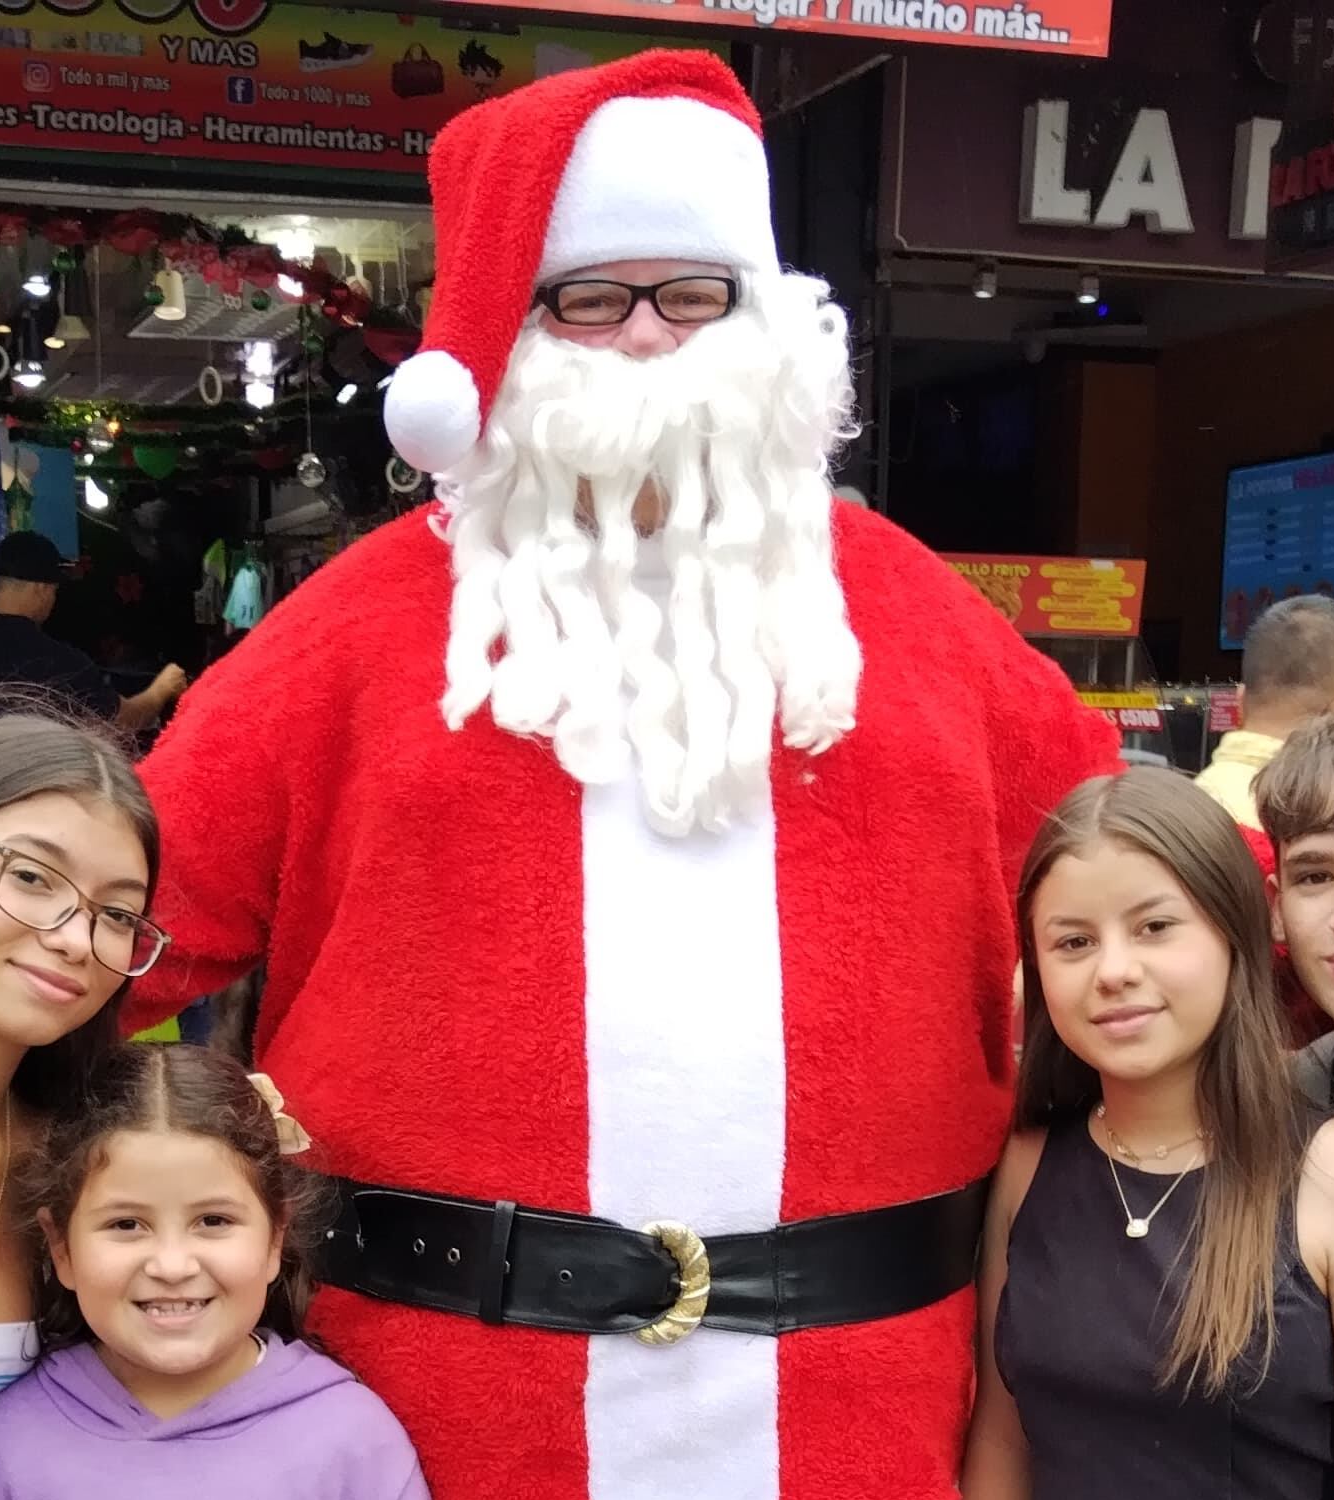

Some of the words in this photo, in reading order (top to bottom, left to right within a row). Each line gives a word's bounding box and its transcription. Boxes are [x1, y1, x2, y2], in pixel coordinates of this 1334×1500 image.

[850, 0, 967, 33] mucho
[974, 4, 1070, 44] más...
[162, 35, 183, 62] Y
[188, 38, 260, 68] MAS
[60, 66, 94, 86] Todo
[96, 74, 105, 85] a
[106, 73, 129, 88] mil
[131, 76, 141, 92] y
[260, 82, 289, 100] Todo
[205, 114, 387, 153] Herramientas
[1023, 98, 1195, 234] LA
[992, 563, 1031, 577] FRITO
